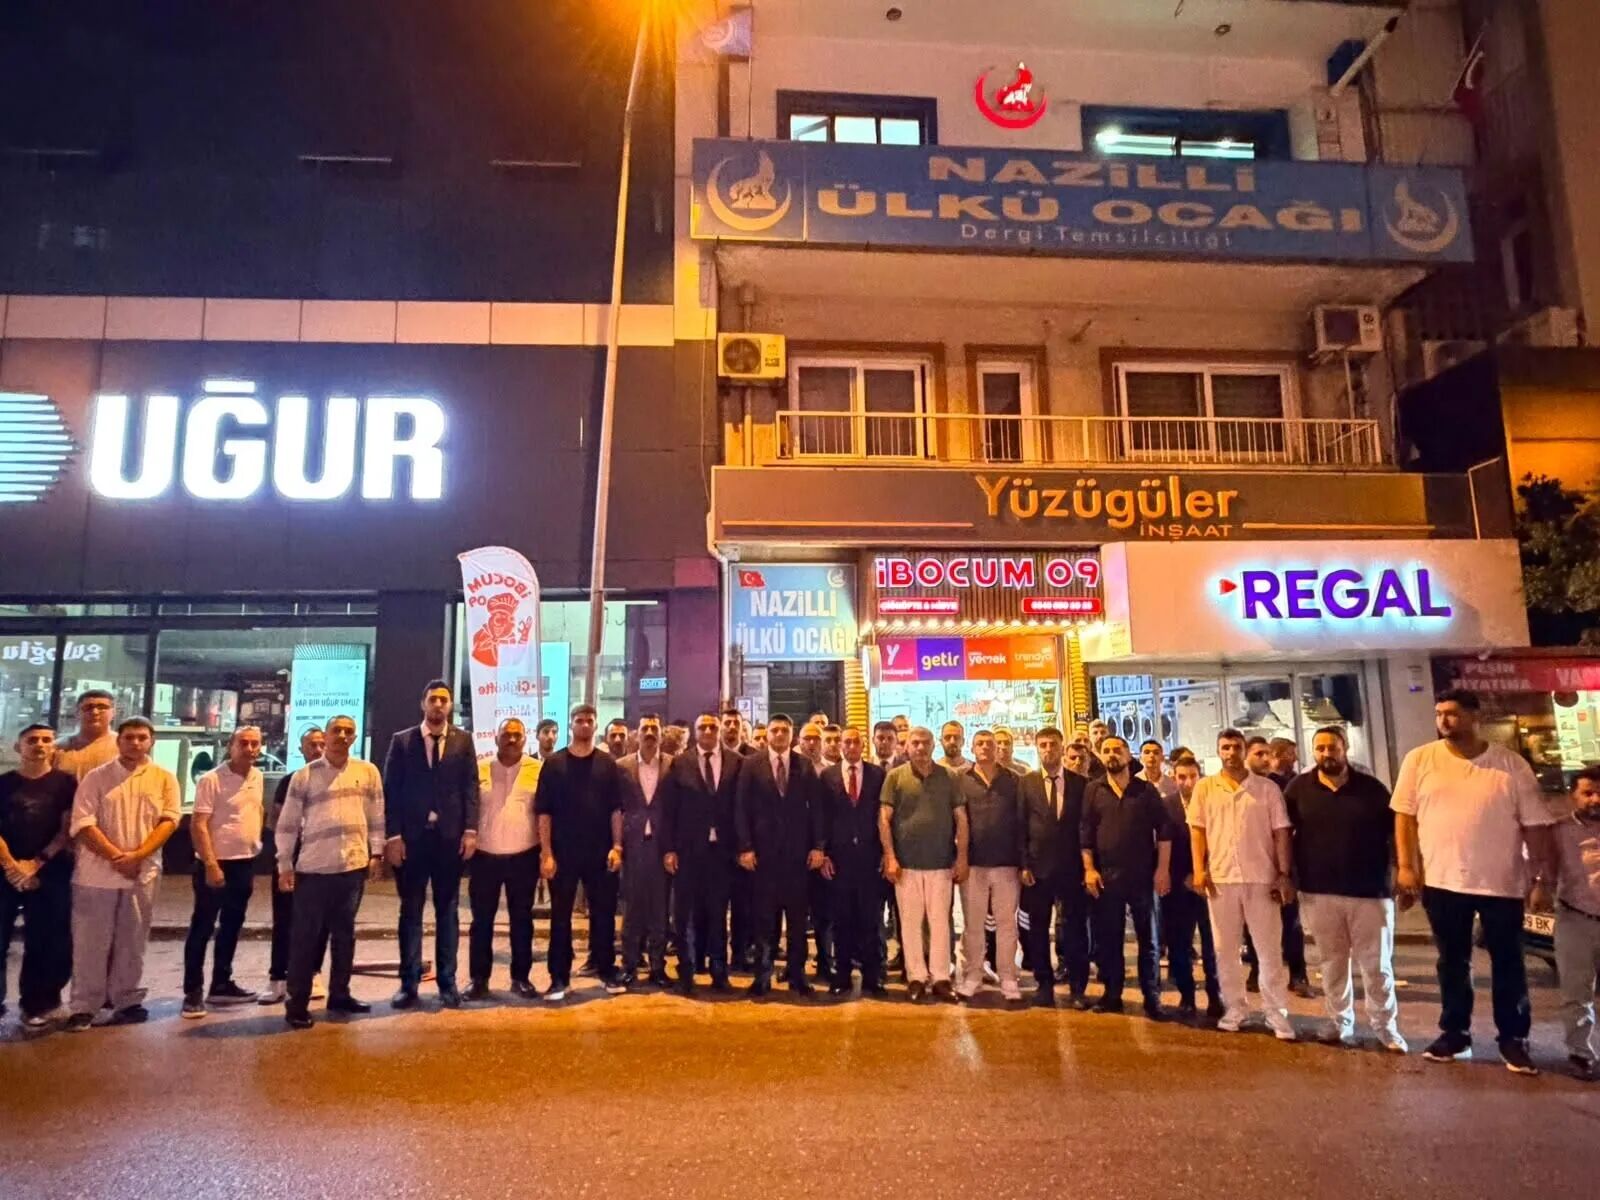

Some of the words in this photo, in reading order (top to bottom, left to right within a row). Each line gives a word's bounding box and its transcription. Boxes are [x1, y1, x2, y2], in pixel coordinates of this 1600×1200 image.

[928, 156, 1255, 192] NAZİLLİ
[817, 184, 1059, 221] ÜLKÜ
[1092, 199, 1362, 232] OCAĞI
[961, 223, 1043, 244] Dergi
[90, 380, 446, 500] UĞUR
[975, 475, 1238, 528] Yüzügüler
[1140, 522, 1232, 539] İNŞAAT
[1045, 557, 1100, 589] 09
[1241, 568, 1452, 620] REGAL
[735, 623, 785, 654] ÜLKÜ
[793, 623, 857, 654] OCAĞI
